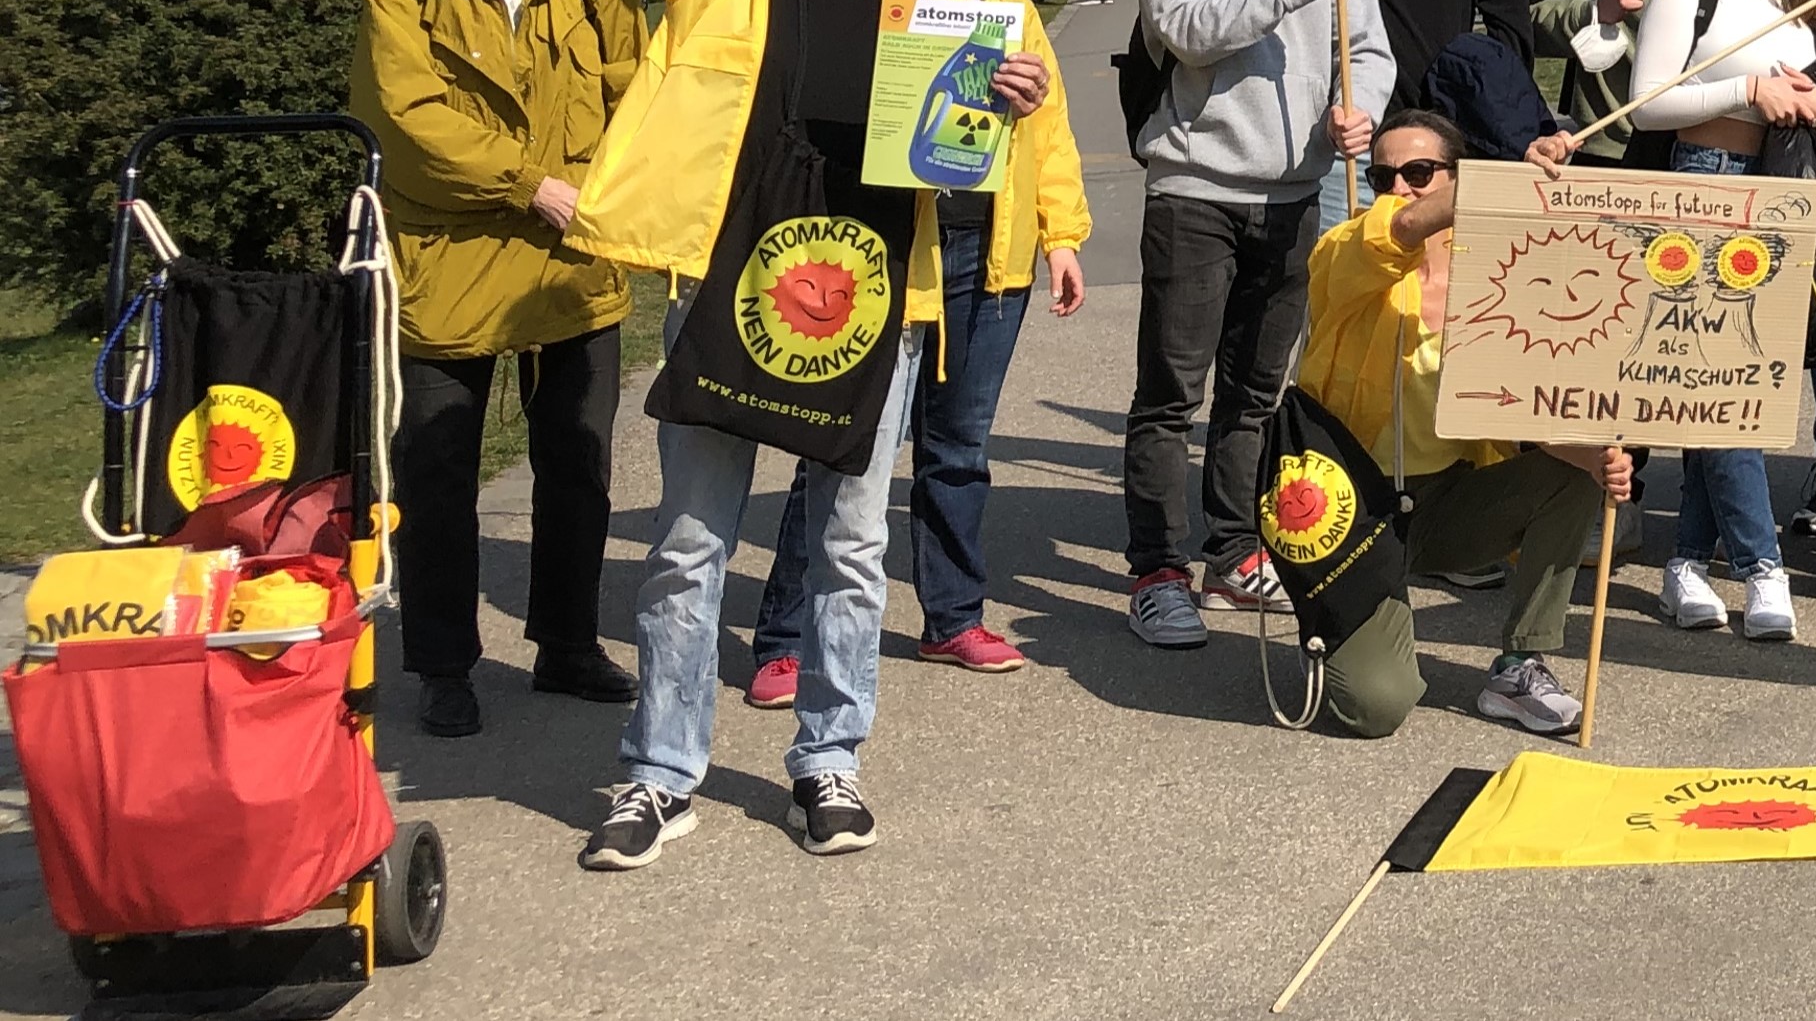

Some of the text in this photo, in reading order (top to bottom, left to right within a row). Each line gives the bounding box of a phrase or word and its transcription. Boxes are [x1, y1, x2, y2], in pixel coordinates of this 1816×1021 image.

[916, 6, 1017, 28] atomstopp
[1550, 188, 1734, 219] atomstopp for future
[757, 221, 886, 297] ATOMKRAFT?
[739, 295, 876, 378] NEIN DANKE
[1655, 303, 1728, 334] AKW
[1657, 335, 1689, 356] als
[697, 375, 852, 426] www.atomstopp.at
[1533, 385, 1620, 422] NEIN
[1274, 488, 1353, 561] NEIN DANKE
[1306, 520, 1388, 601] www.atomstopp.at
